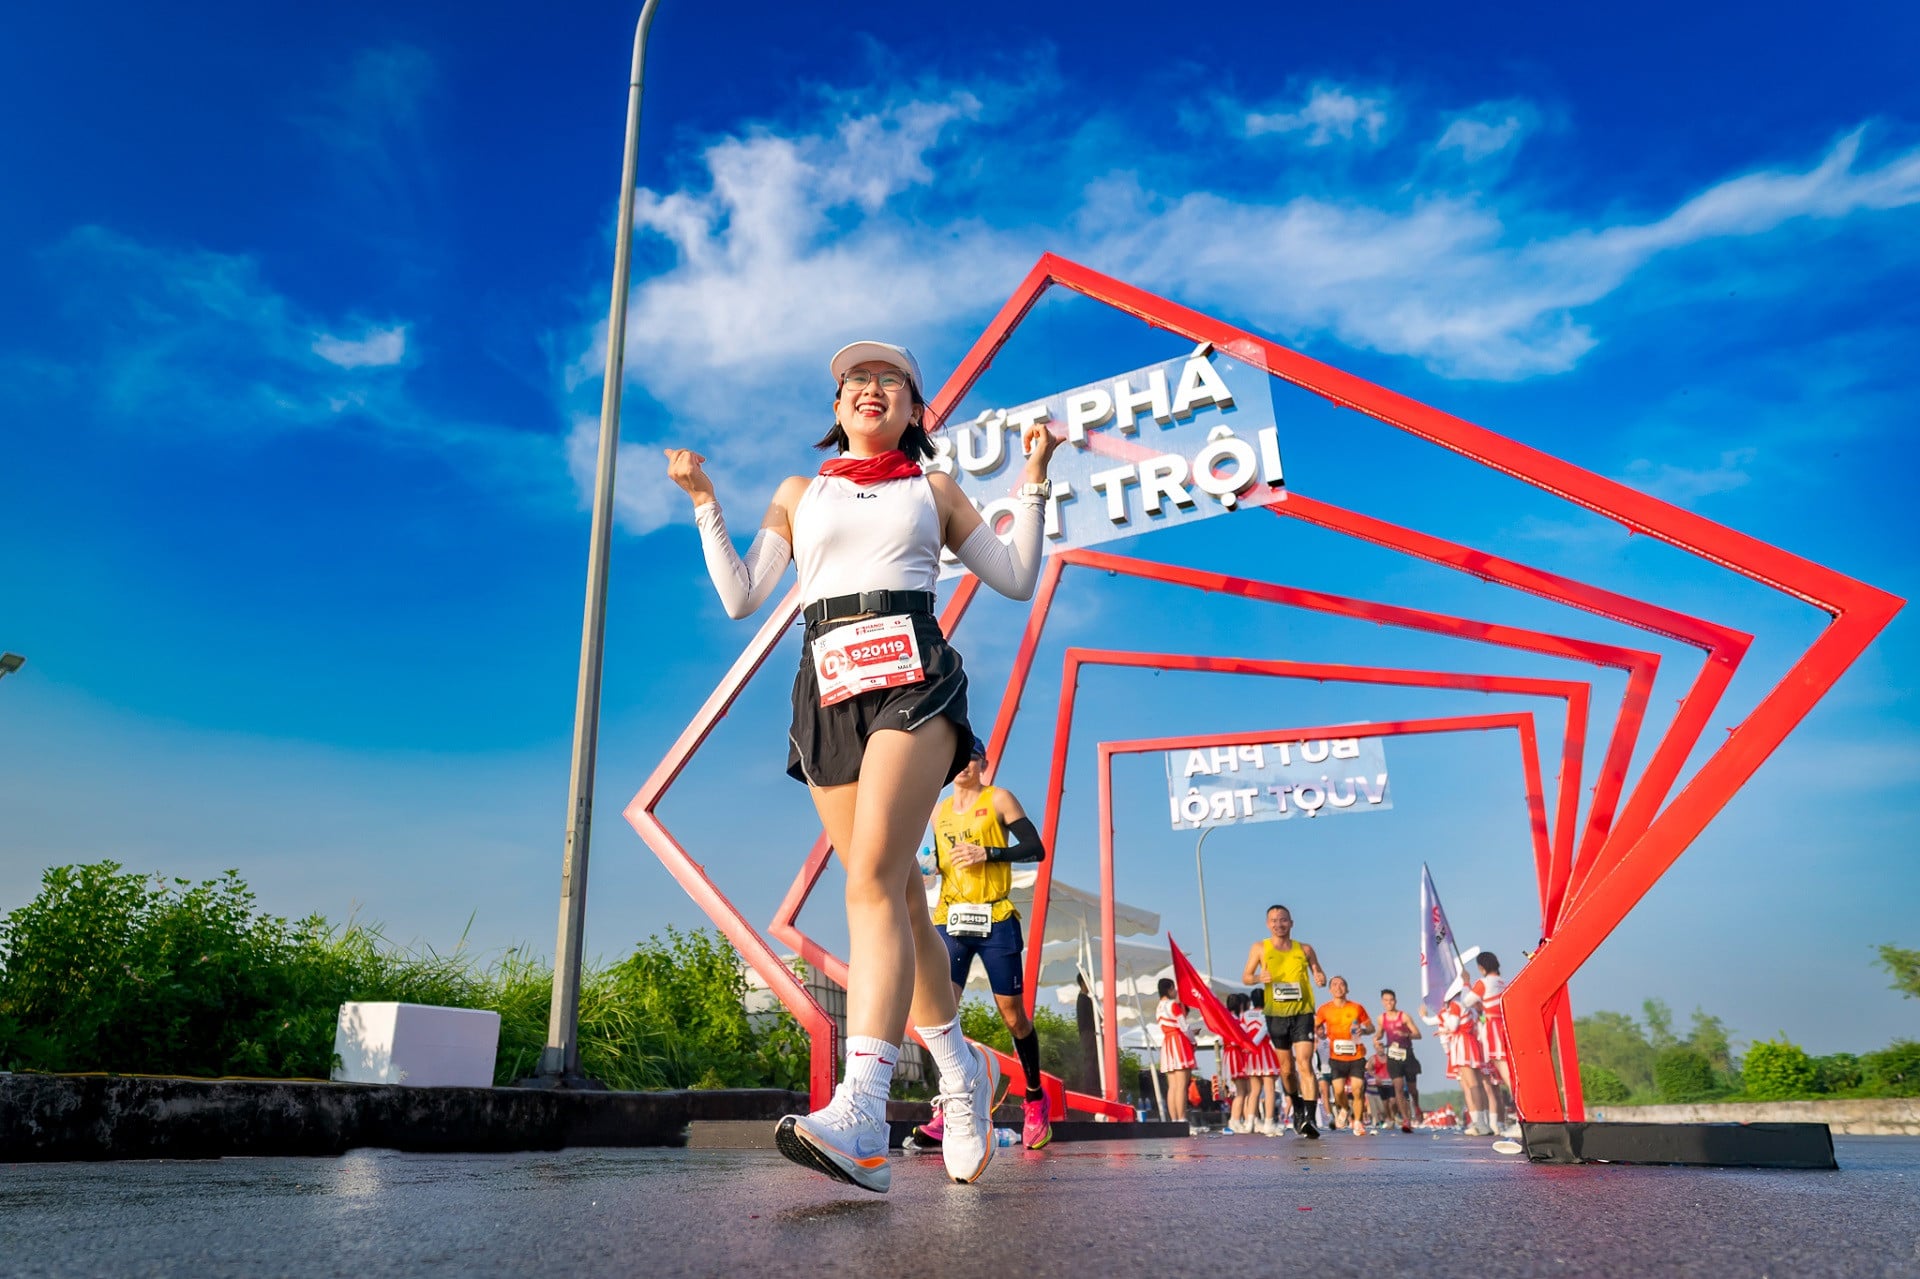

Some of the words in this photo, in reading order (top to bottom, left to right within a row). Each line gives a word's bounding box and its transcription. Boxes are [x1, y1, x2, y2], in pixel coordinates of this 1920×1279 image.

[1066, 341, 1235, 449] PHÁ
[1090, 424, 1285, 524] TRỘI
[850, 640, 905, 661] 920119
